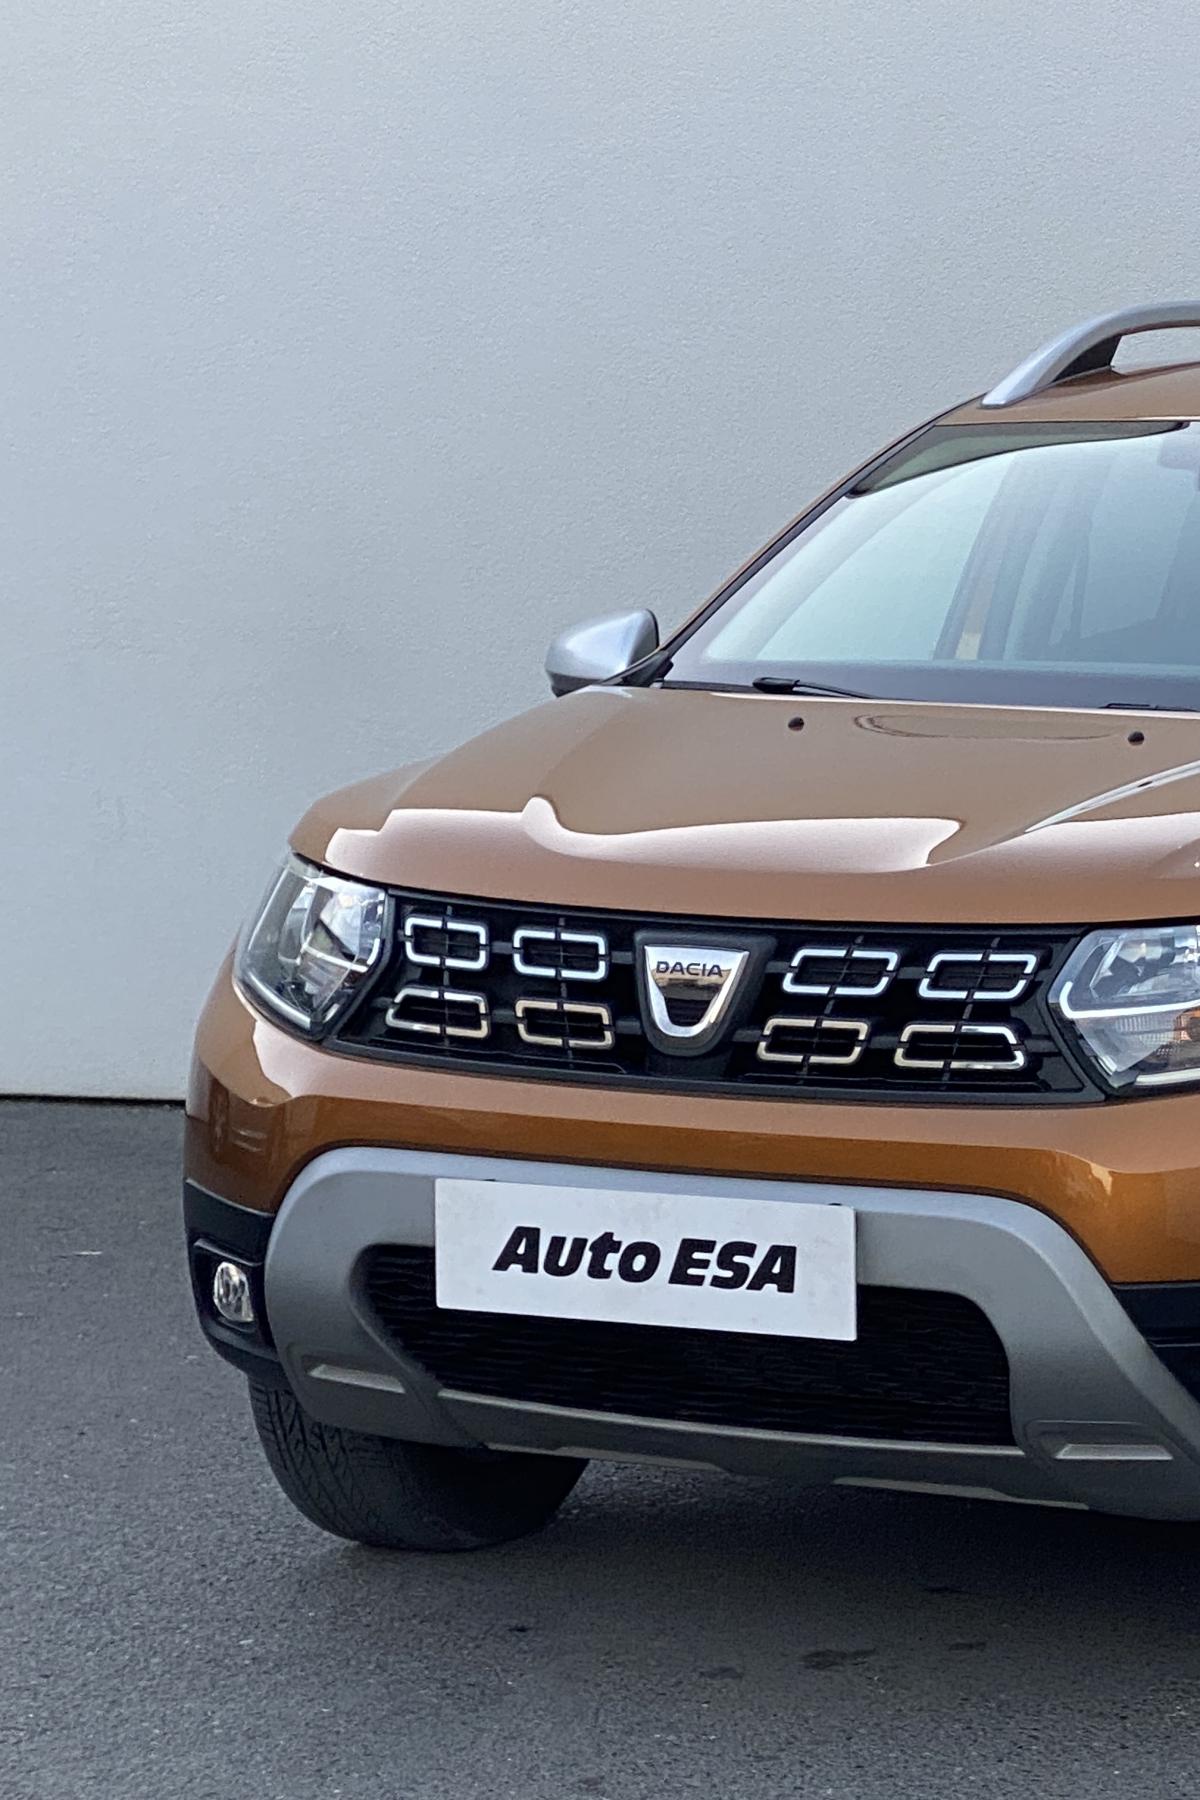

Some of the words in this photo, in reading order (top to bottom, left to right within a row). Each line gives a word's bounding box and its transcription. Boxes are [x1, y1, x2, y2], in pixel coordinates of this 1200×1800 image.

[656, 961, 723, 977] DACIA
[492, 1226, 661, 1282] Auto
[668, 1238, 797, 1293] ESA
